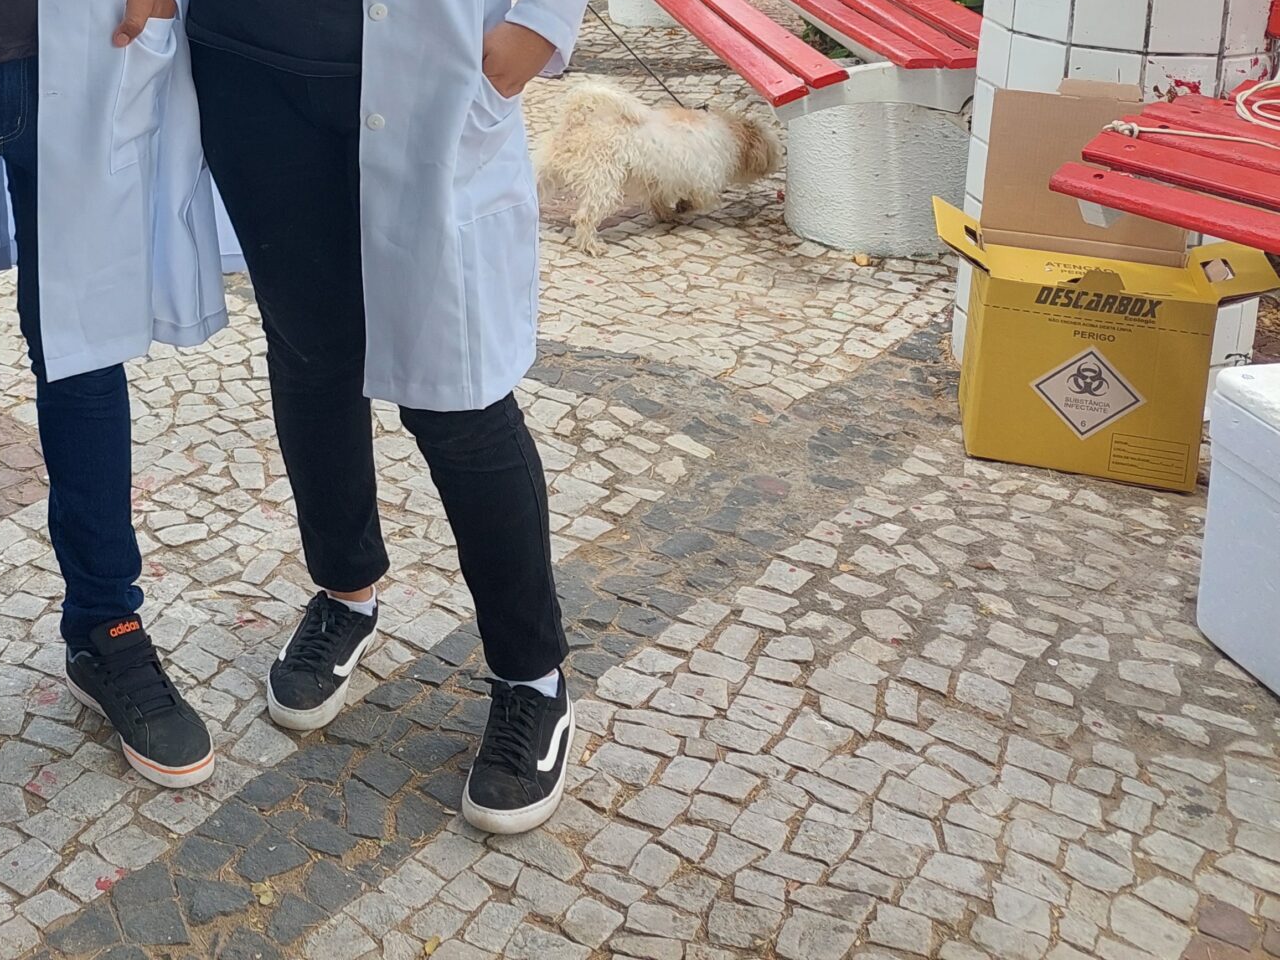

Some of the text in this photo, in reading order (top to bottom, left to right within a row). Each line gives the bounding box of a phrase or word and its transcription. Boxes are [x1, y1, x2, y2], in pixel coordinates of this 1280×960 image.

[1034, 285, 1163, 319] DESCARBOX
[1073, 329, 1116, 343] PERIGO
[1063, 402, 1109, 414] INFECTANTE
[1064, 396, 1111, 409] SUBSTÂNCIA
[1080, 419, 1087, 428] 6
[108, 619, 141, 638] adidas
